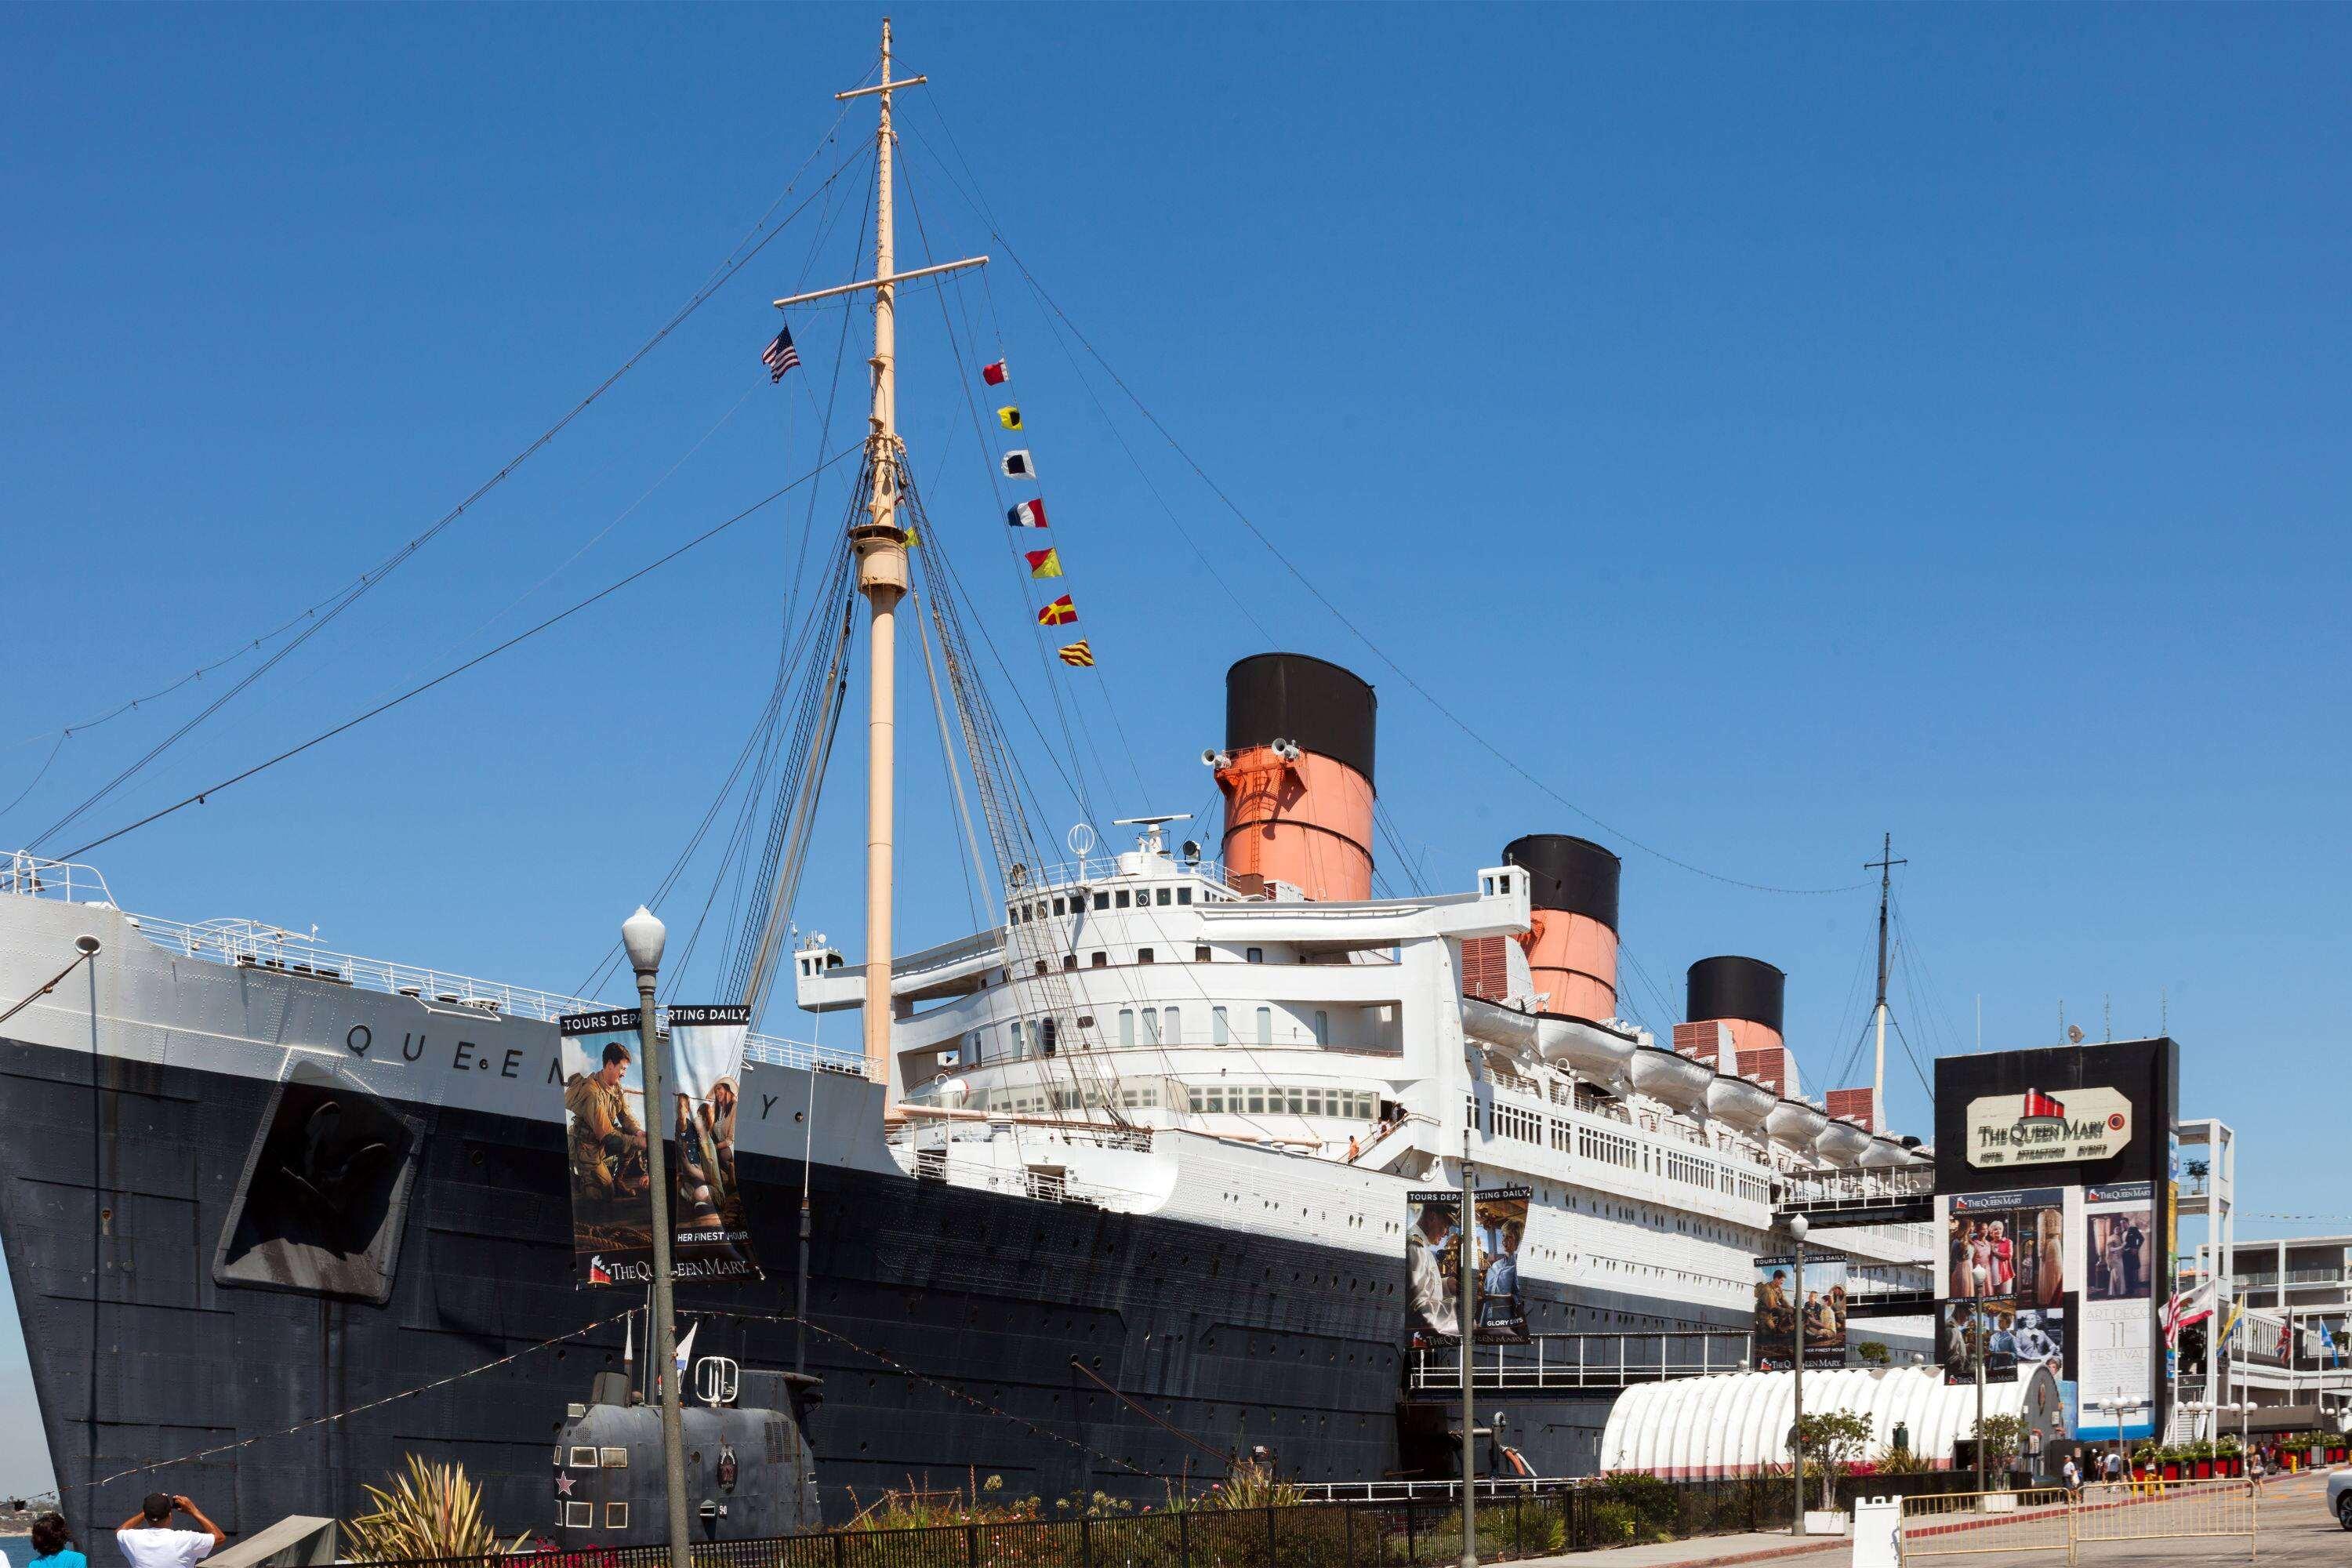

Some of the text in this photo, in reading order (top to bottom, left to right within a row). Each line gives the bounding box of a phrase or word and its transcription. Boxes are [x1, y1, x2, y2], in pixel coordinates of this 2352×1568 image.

[564, 1015, 607, 1031] TOURS
[2010, 1123, 2060, 1145] QUEEN
[2060, 1119, 2106, 1141] MARY
[677, 1231, 750, 1243] HER FINEST HOUR
[2089, 1348, 2148, 1362] FESTIVAL
